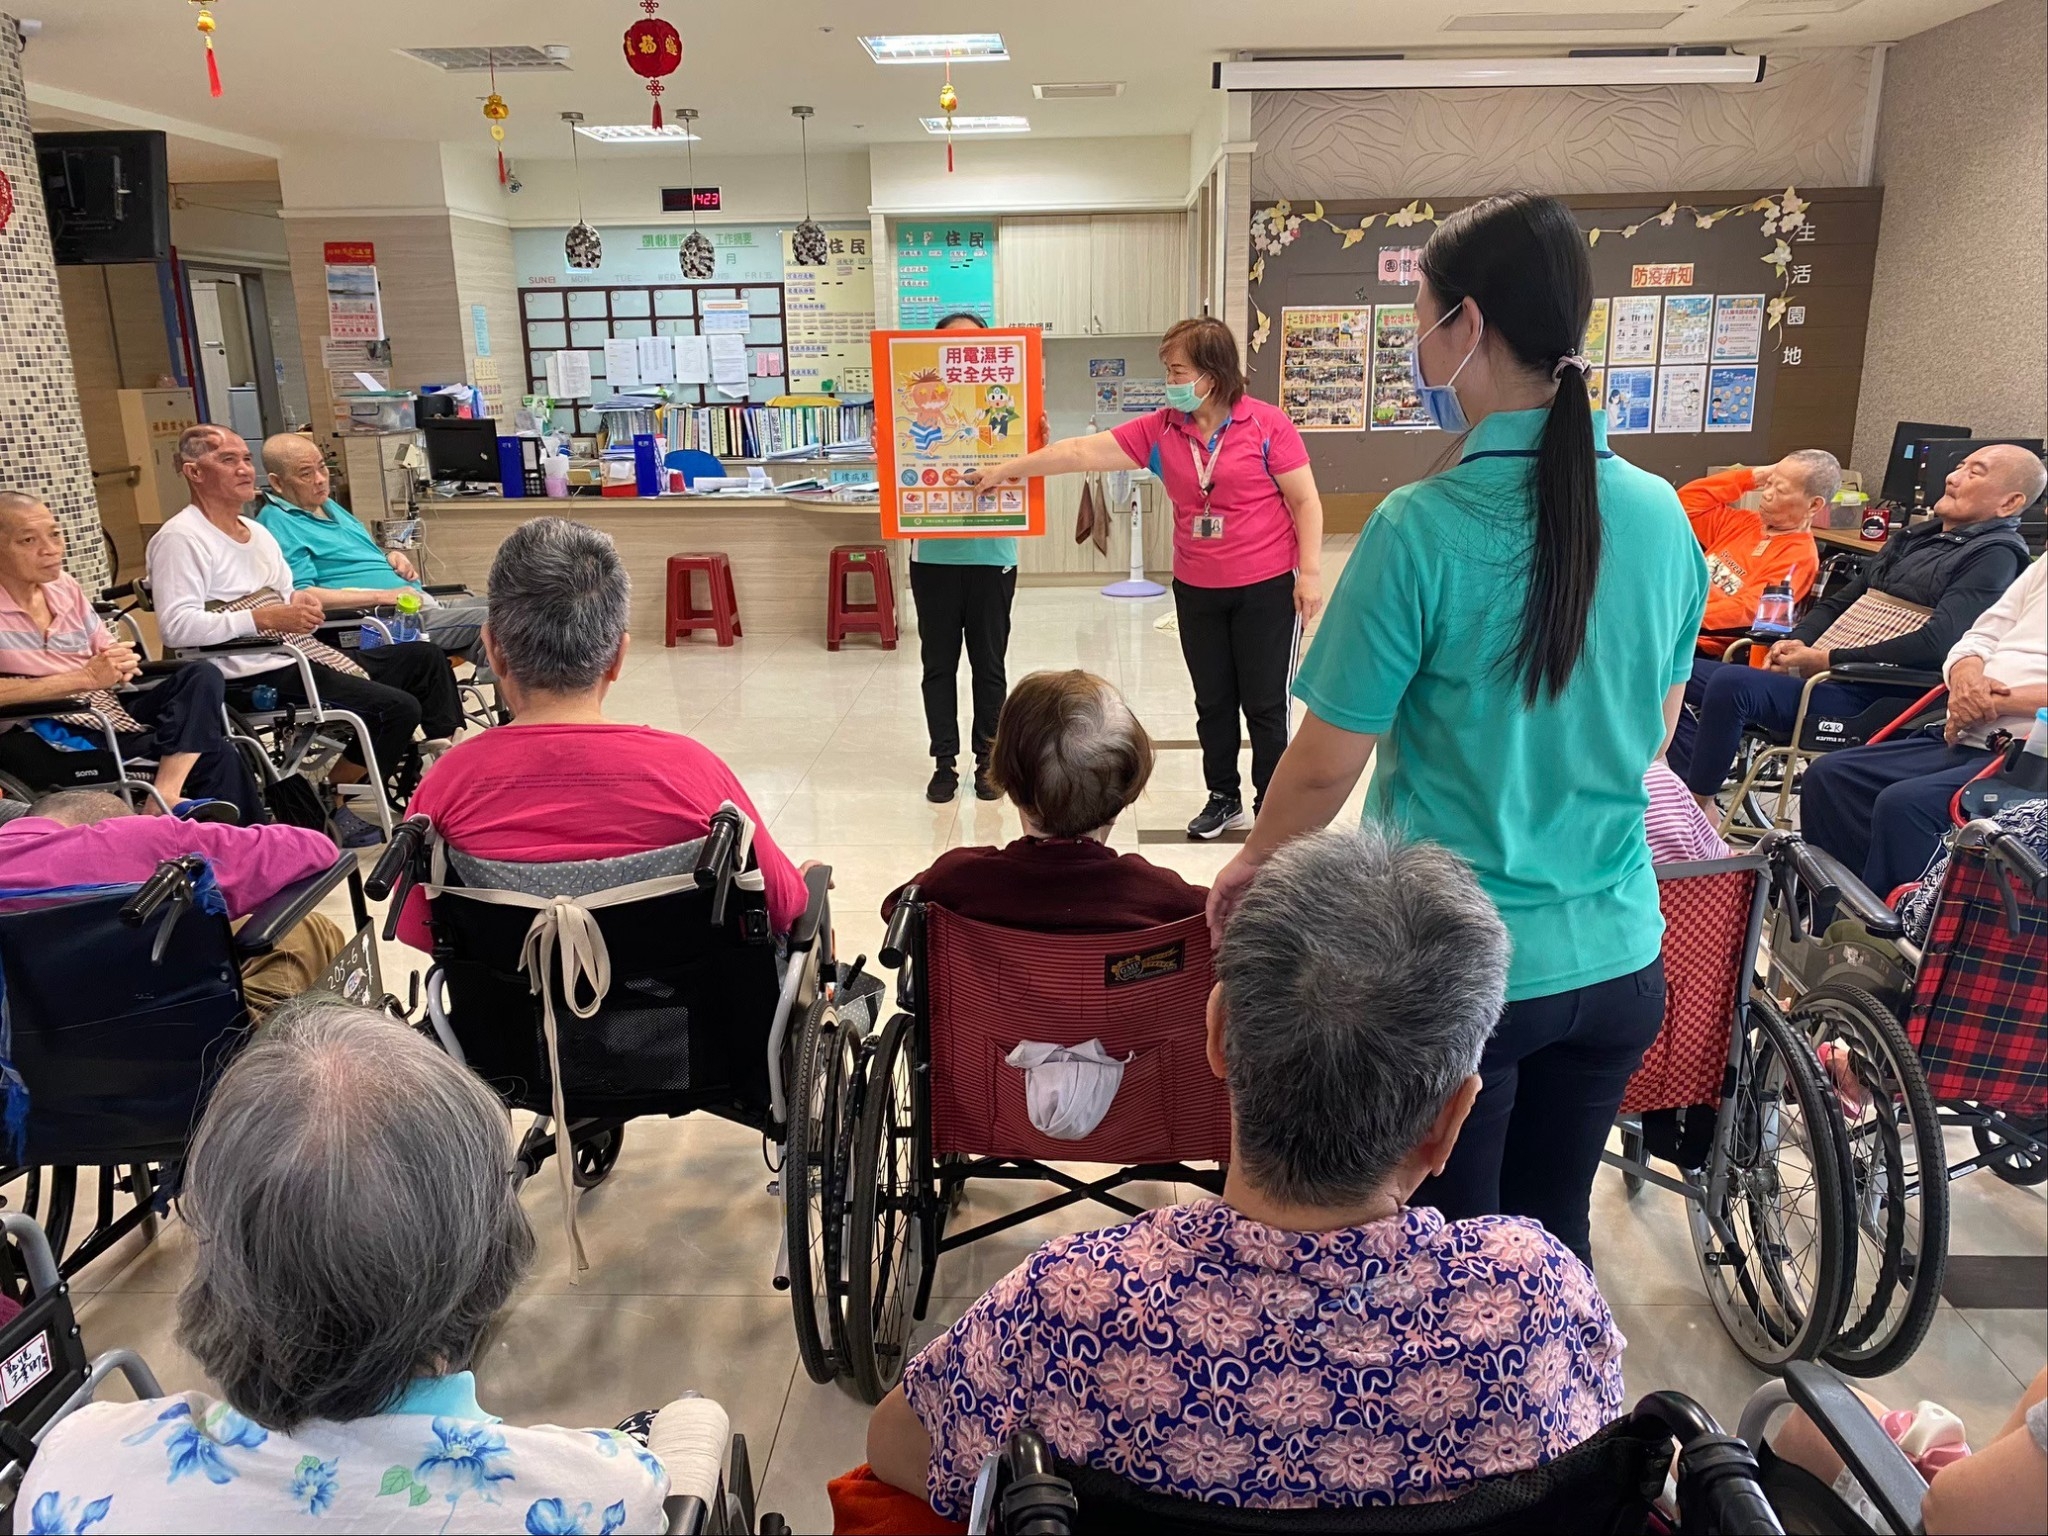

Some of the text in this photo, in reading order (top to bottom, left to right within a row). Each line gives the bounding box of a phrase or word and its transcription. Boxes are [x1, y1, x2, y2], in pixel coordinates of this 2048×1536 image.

[829, 238, 865, 255] 住民
[945, 231, 984, 248] 住民
[726, 253, 737, 265] 月
[1633, 267, 1692, 286] 防疫新知
[1782, 222, 1816, 365] 生活園地
[945, 366, 1015, 384] 安全失守
[75, 769, 99, 778] soma
